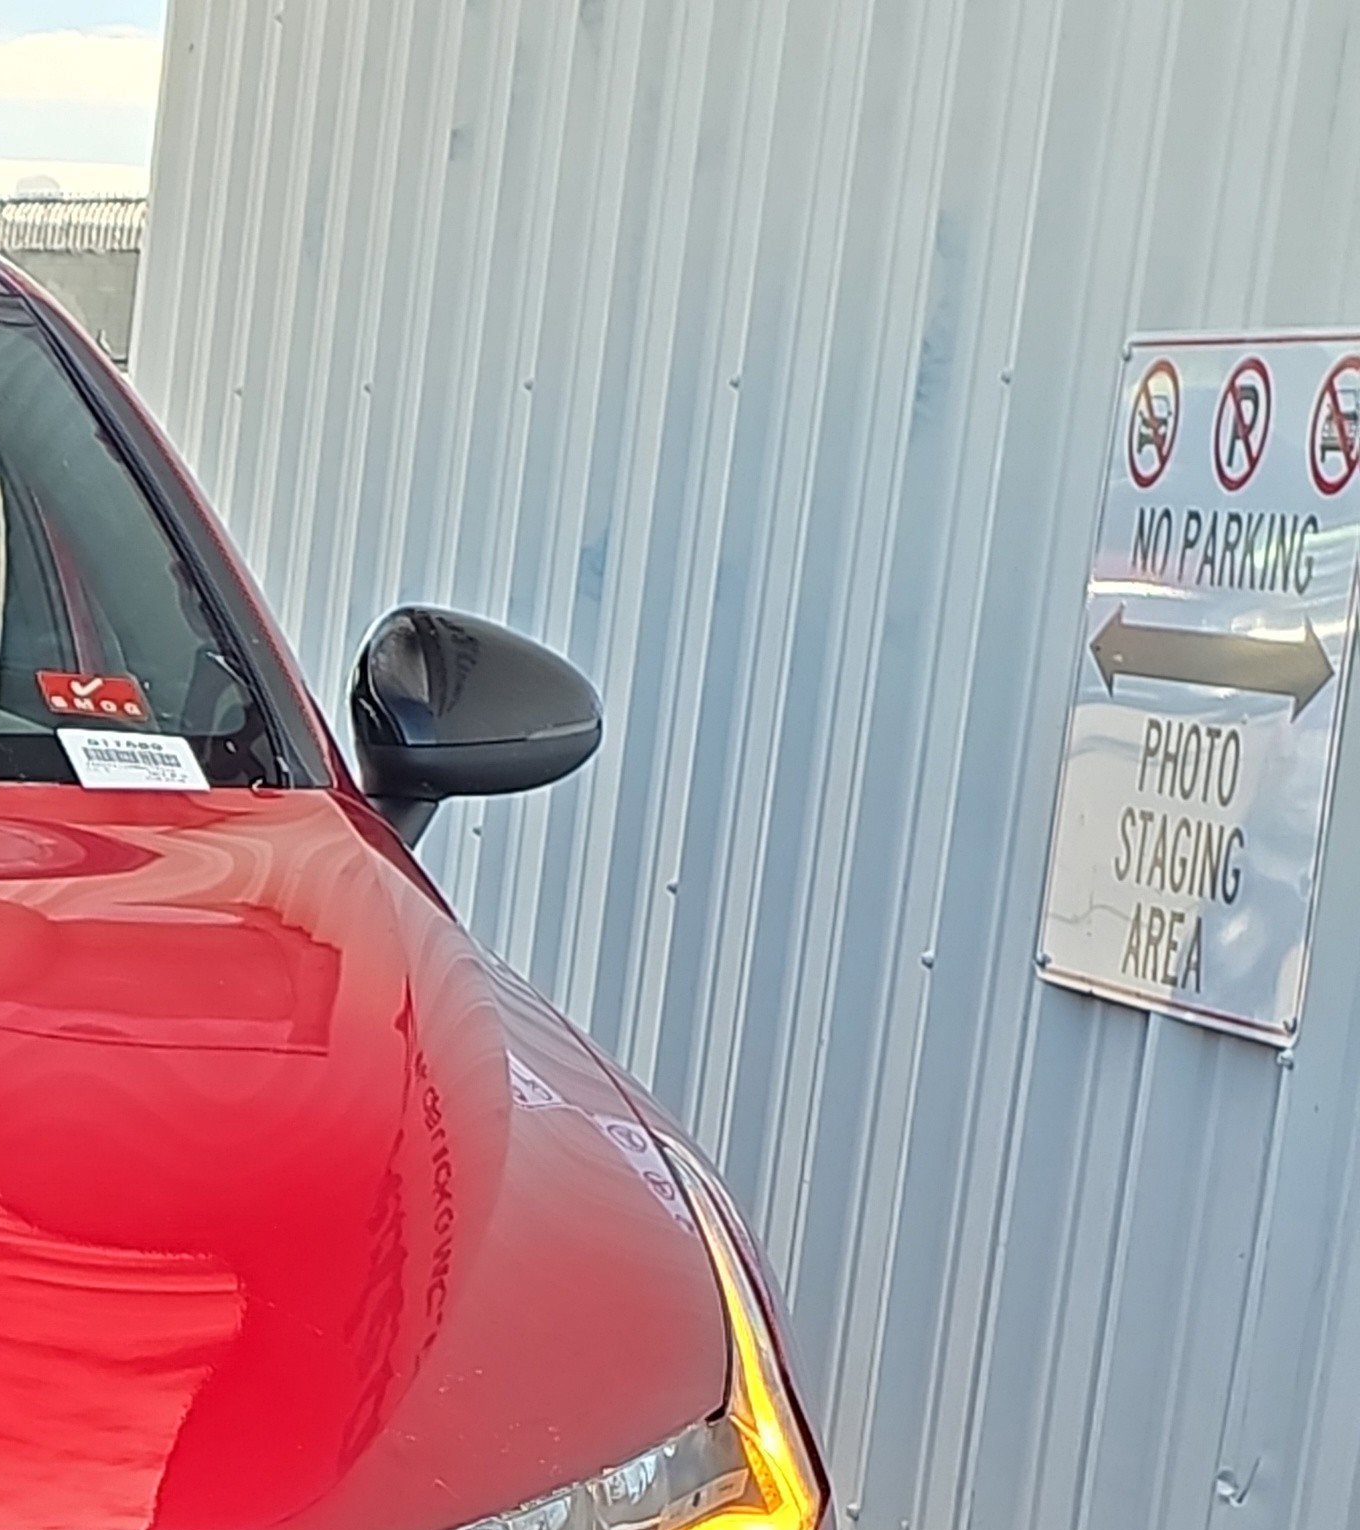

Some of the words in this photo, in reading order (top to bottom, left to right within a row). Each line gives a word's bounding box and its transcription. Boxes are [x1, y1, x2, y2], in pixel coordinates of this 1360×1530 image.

[1131, 506, 1173, 578] NO
[1177, 508, 1320, 595] PARKING
[1137, 717, 1241, 807] PHOTO
[1114, 806, 1245, 905] STAGING
[1121, 901, 1202, 994] AREA
